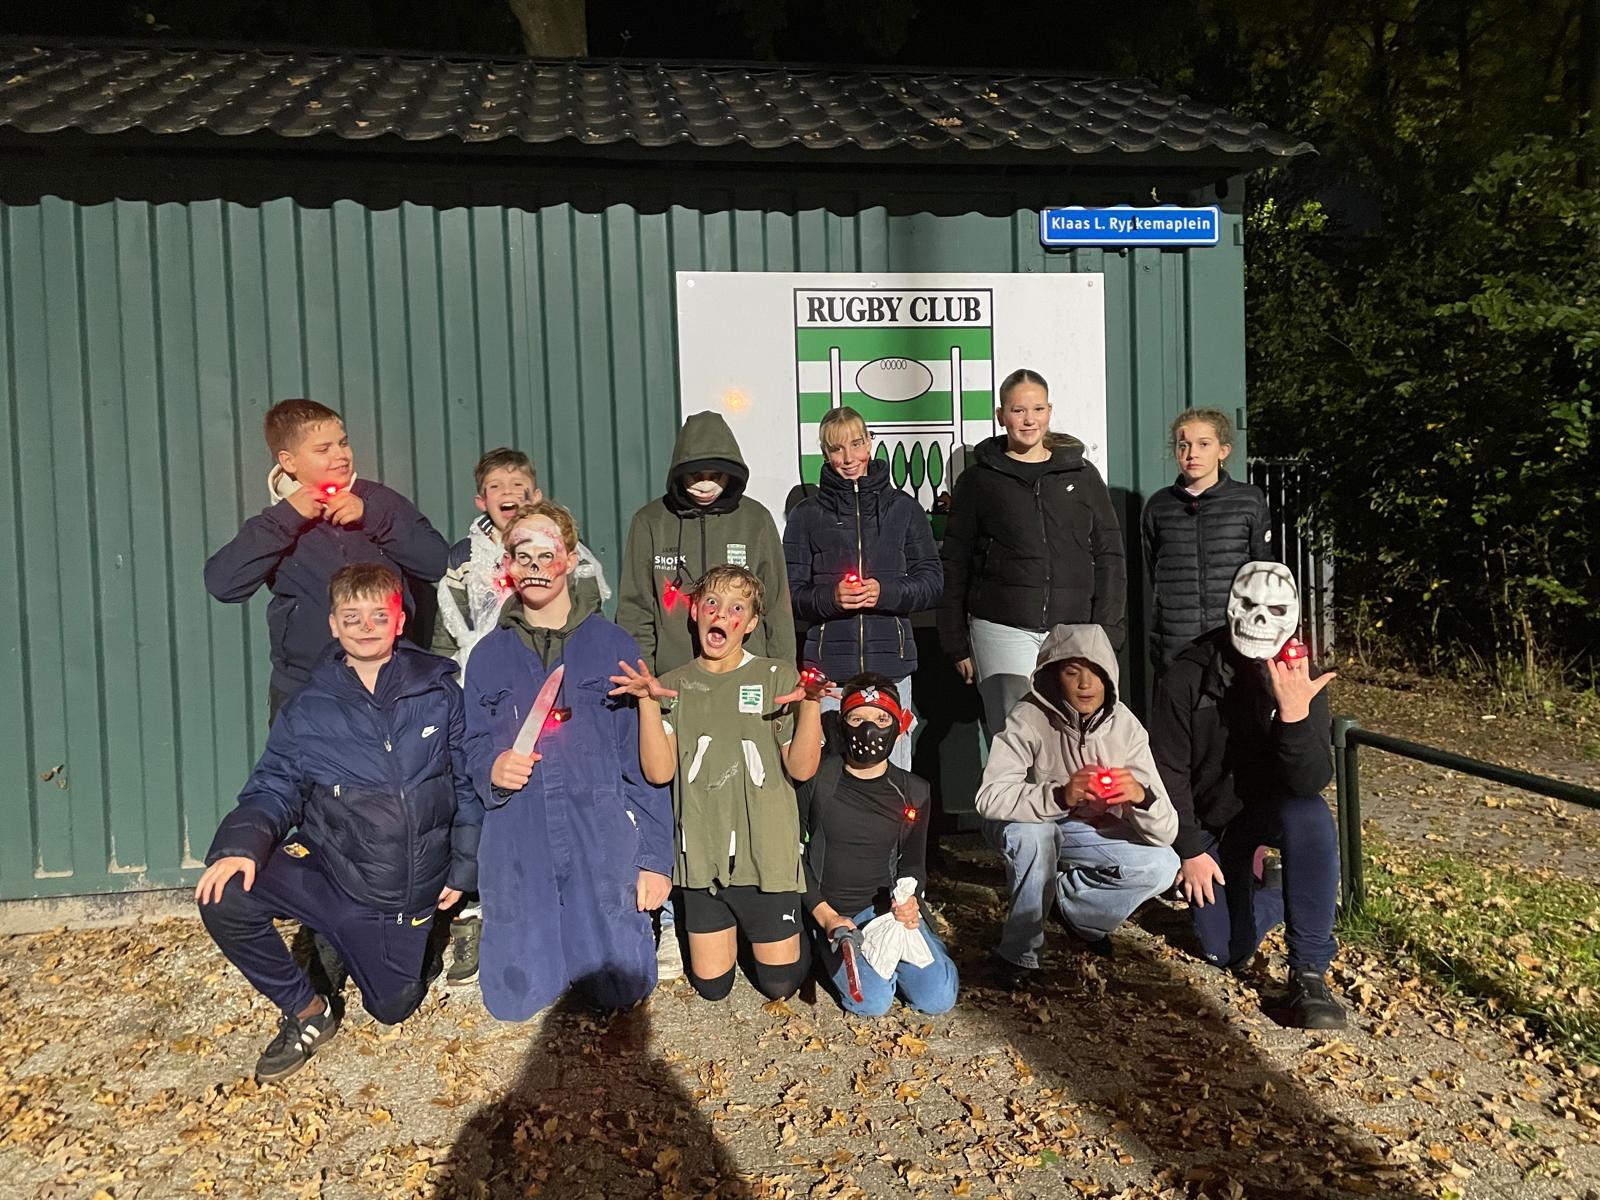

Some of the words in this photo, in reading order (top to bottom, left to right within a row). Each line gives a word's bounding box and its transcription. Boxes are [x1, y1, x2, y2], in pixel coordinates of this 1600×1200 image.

[1051, 216, 1091, 230] Klaas
[1094, 216, 1106, 230] L.
[1109, 216, 1211, 233] Rypkemaplein
[806, 296, 904, 322] RUGBY
[909, 296, 981, 322] CLUB
